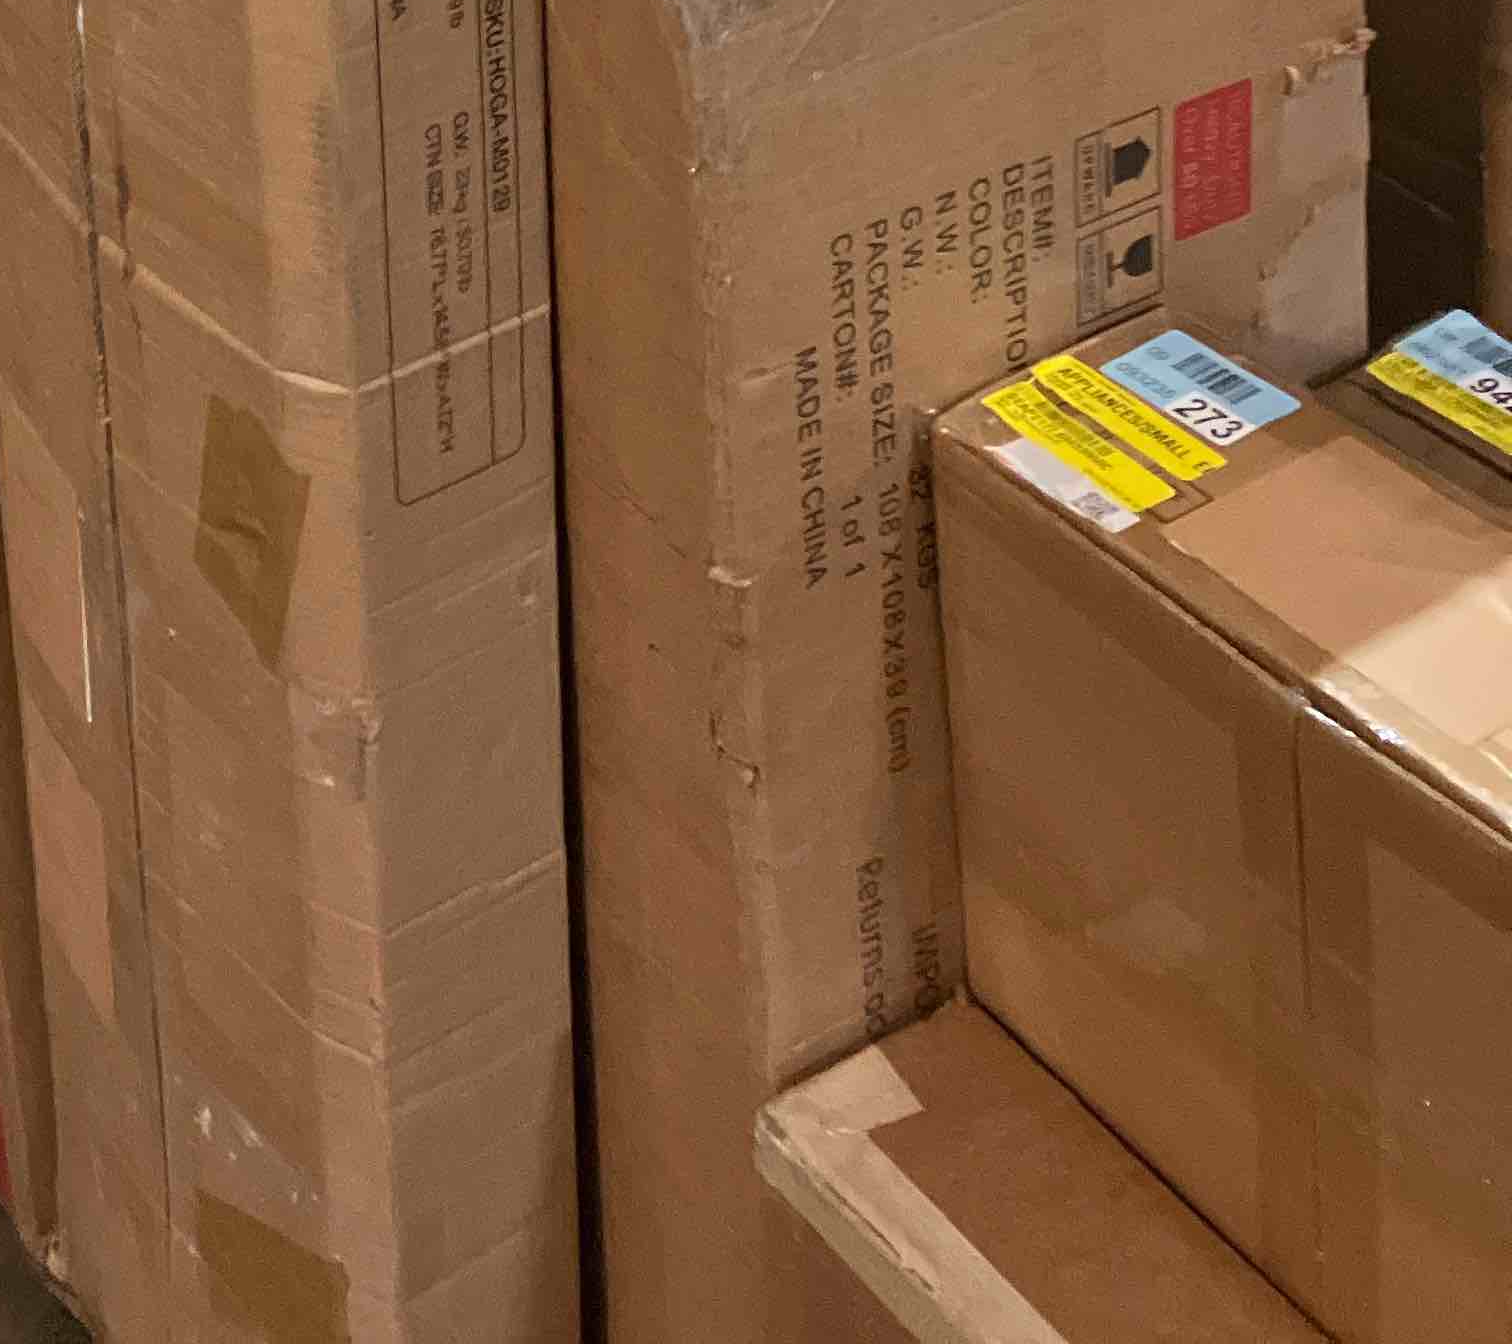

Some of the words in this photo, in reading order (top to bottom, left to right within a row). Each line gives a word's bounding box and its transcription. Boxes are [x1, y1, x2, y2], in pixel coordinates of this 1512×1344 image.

[967, 175, 993, 305] COLOR:
[829, 232, 859, 404] CARTON#:
[864, 217, 893, 378] PACKAGE
[794, 345, 823, 444] MADE
[869, 381, 897, 468] SIZE:
[1173, 398, 1243, 439] 273
[798, 446, 823, 482] IN
[839, 494, 864, 513] 1
[877, 483, 903, 538] 108
[800, 485, 828, 592] CHINA
[844, 562, 867, 580] 1
[855, 856, 885, 989] Returns
